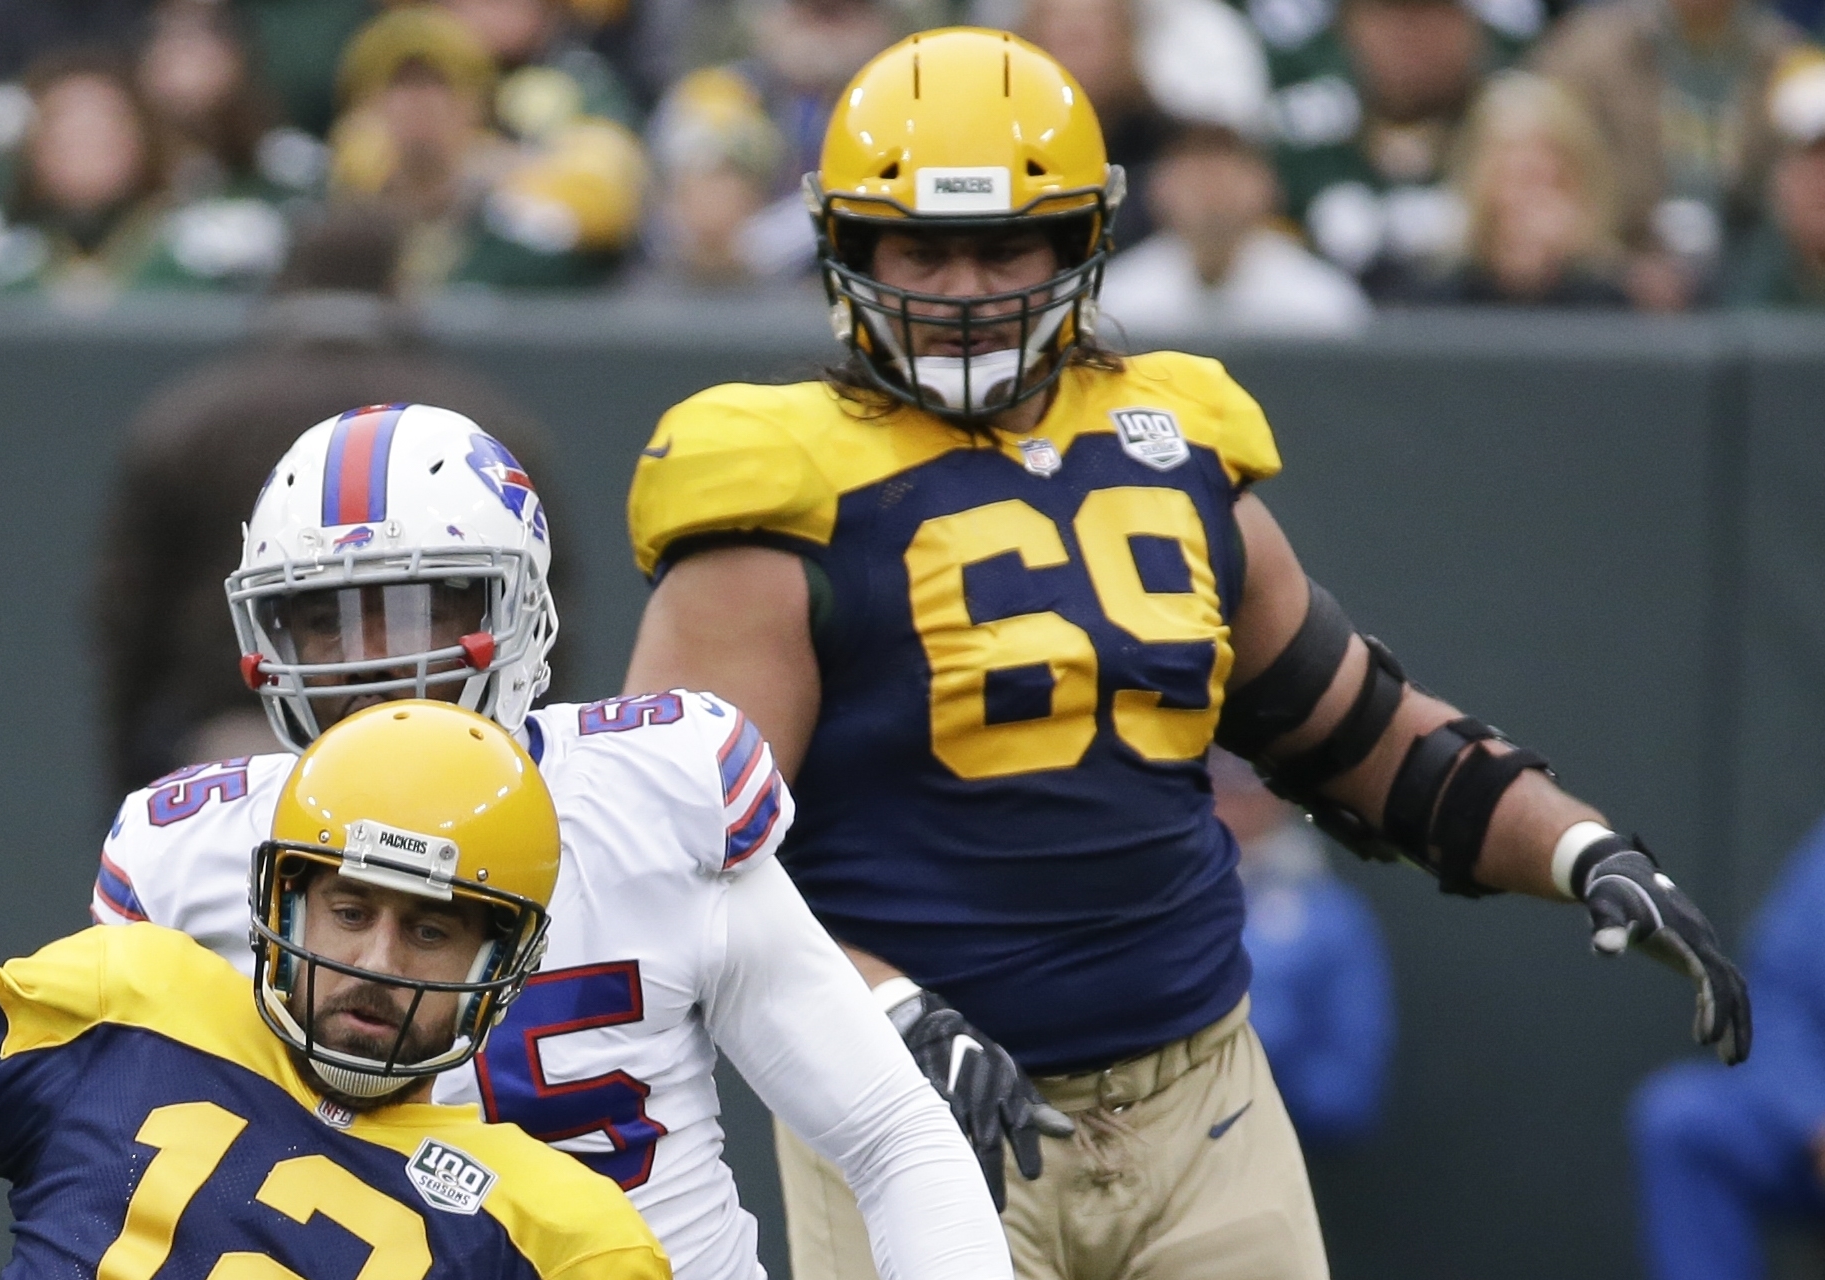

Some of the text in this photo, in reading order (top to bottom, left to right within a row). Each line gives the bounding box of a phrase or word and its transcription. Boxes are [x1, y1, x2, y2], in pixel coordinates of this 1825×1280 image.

[1120, 412, 1174, 438] 100
[904, 486, 1234, 780] 69
[379, 831, 428, 855] PACKERS
[323, 1100, 348, 1123] NFL
[423, 1146, 486, 1193] 100
[418, 1175, 471, 1206] SEASONS
